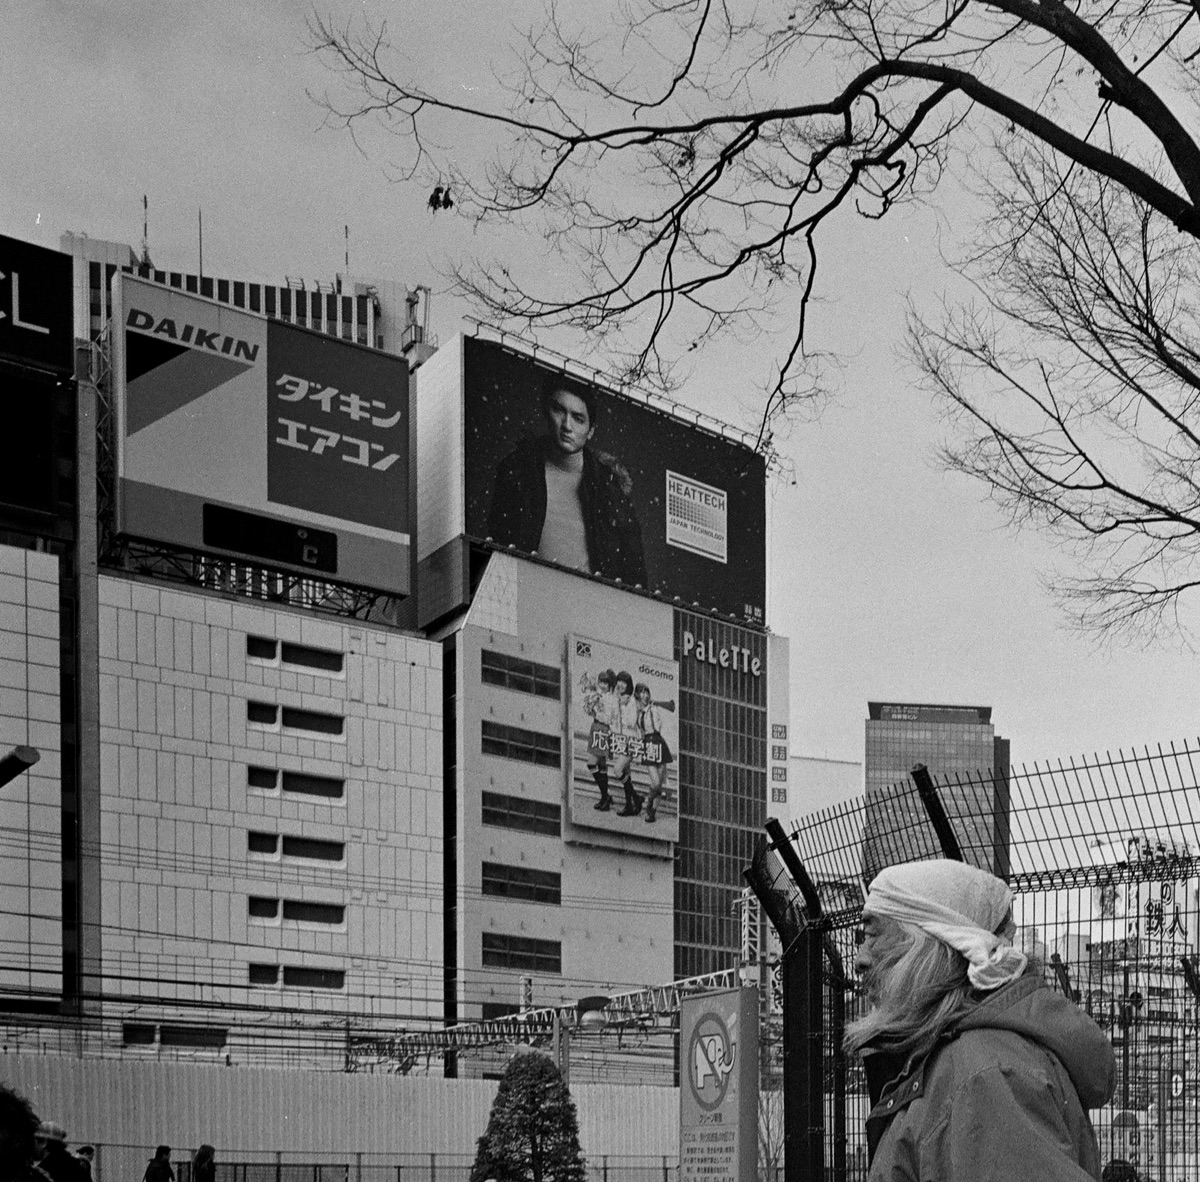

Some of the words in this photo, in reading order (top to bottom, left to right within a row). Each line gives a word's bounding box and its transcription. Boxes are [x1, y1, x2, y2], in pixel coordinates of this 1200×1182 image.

[126, 307, 260, 362] DAIKIN
[275, 373, 402, 429] ダイキン
[275, 416, 401, 472] エアコン
[668, 479, 726, 512] HEATTECH
[669, 517, 688, 530] JAPAN
[690, 523, 725, 542] TECHNOLOGY
[638, 663, 675, 682] docomo
[591, 729, 663, 764] 応援学割
